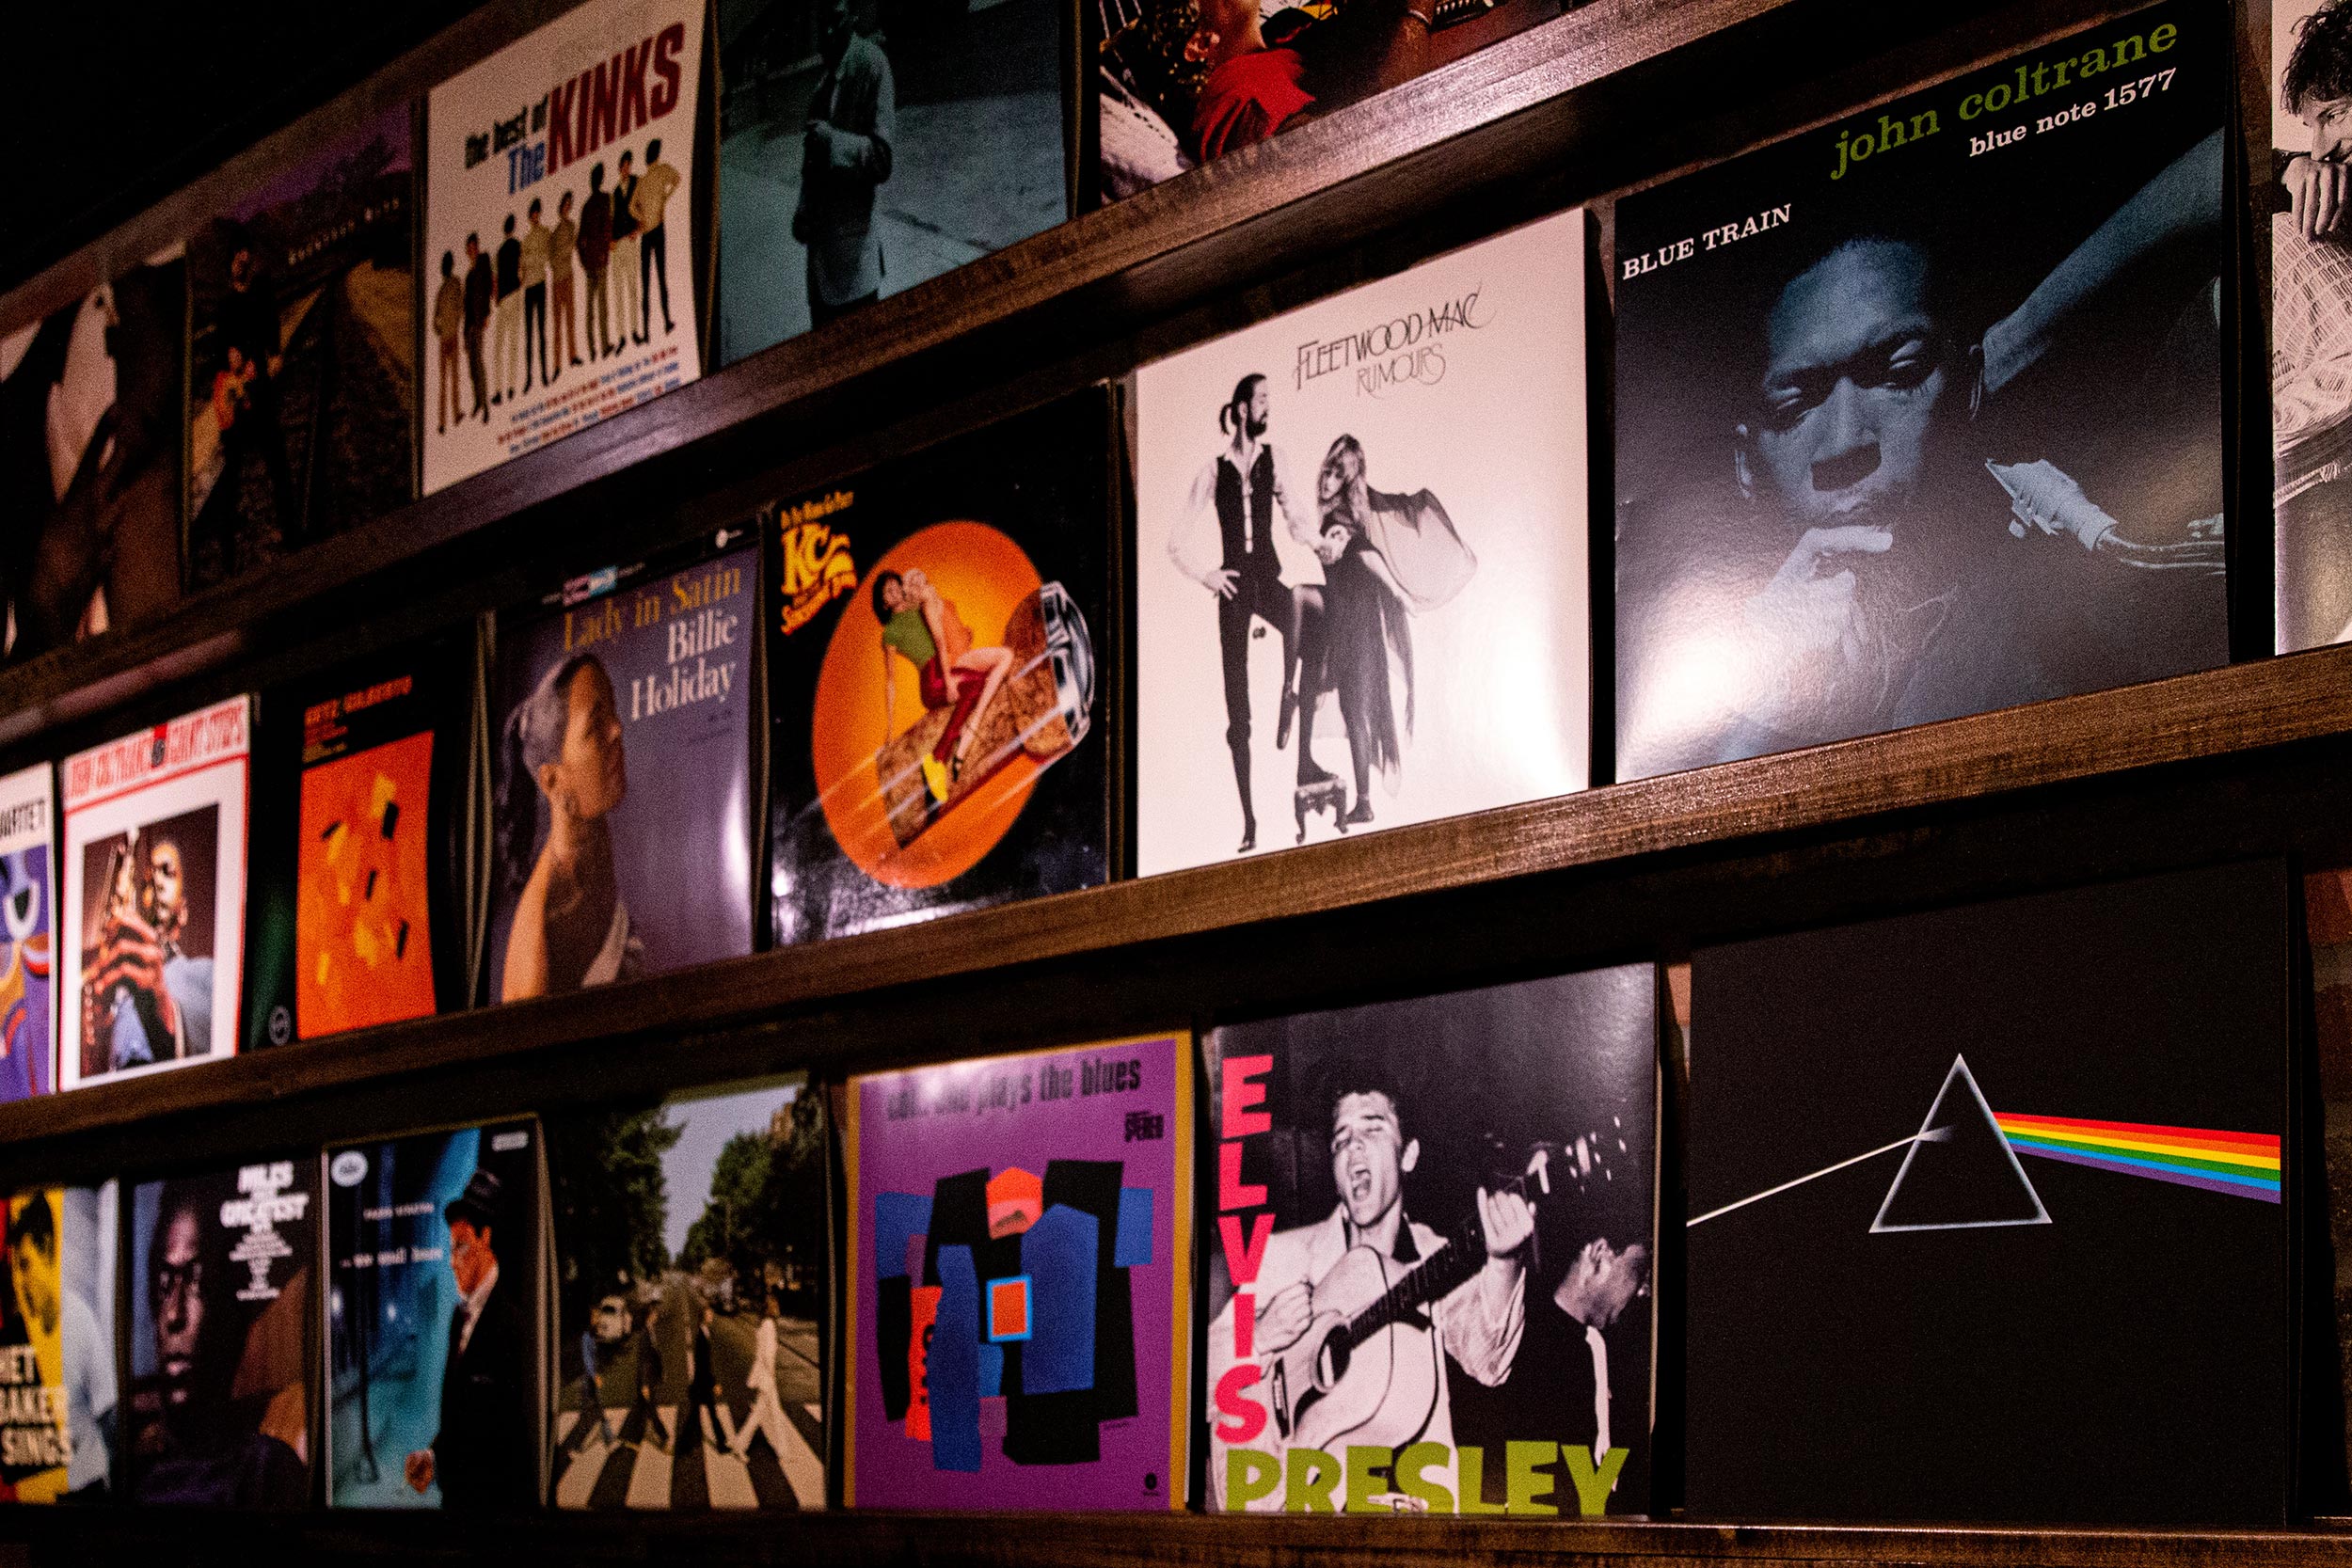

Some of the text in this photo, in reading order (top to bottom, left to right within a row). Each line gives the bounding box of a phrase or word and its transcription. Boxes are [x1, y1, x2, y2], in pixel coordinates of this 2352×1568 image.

[493, 105, 528, 155] best
[547, 21, 685, 177] KINKS
[1831, 23, 2178, 180] john coltrane
[1969, 68, 2177, 157] blue note 1577
[508, 141, 546, 196] The
[1623, 204, 1792, 280] BLUE TRAIN
[1292, 281, 1497, 390] FLEETWOOD MAC
[1356, 342, 1447, 400] RUMOURS
[564, 598, 624, 652] Lady
[635, 592, 660, 629] in
[671, 567, 741, 616] Satin
[667, 609, 738, 665] Billie
[630, 659, 737, 722] Holiday
[1040, 1064, 1073, 1102] the
[1080, 1057, 1141, 1098] blues
[1215, 1054, 1276, 1444] ELVIS
[1226, 1440, 1629, 1516] PRESLEY
